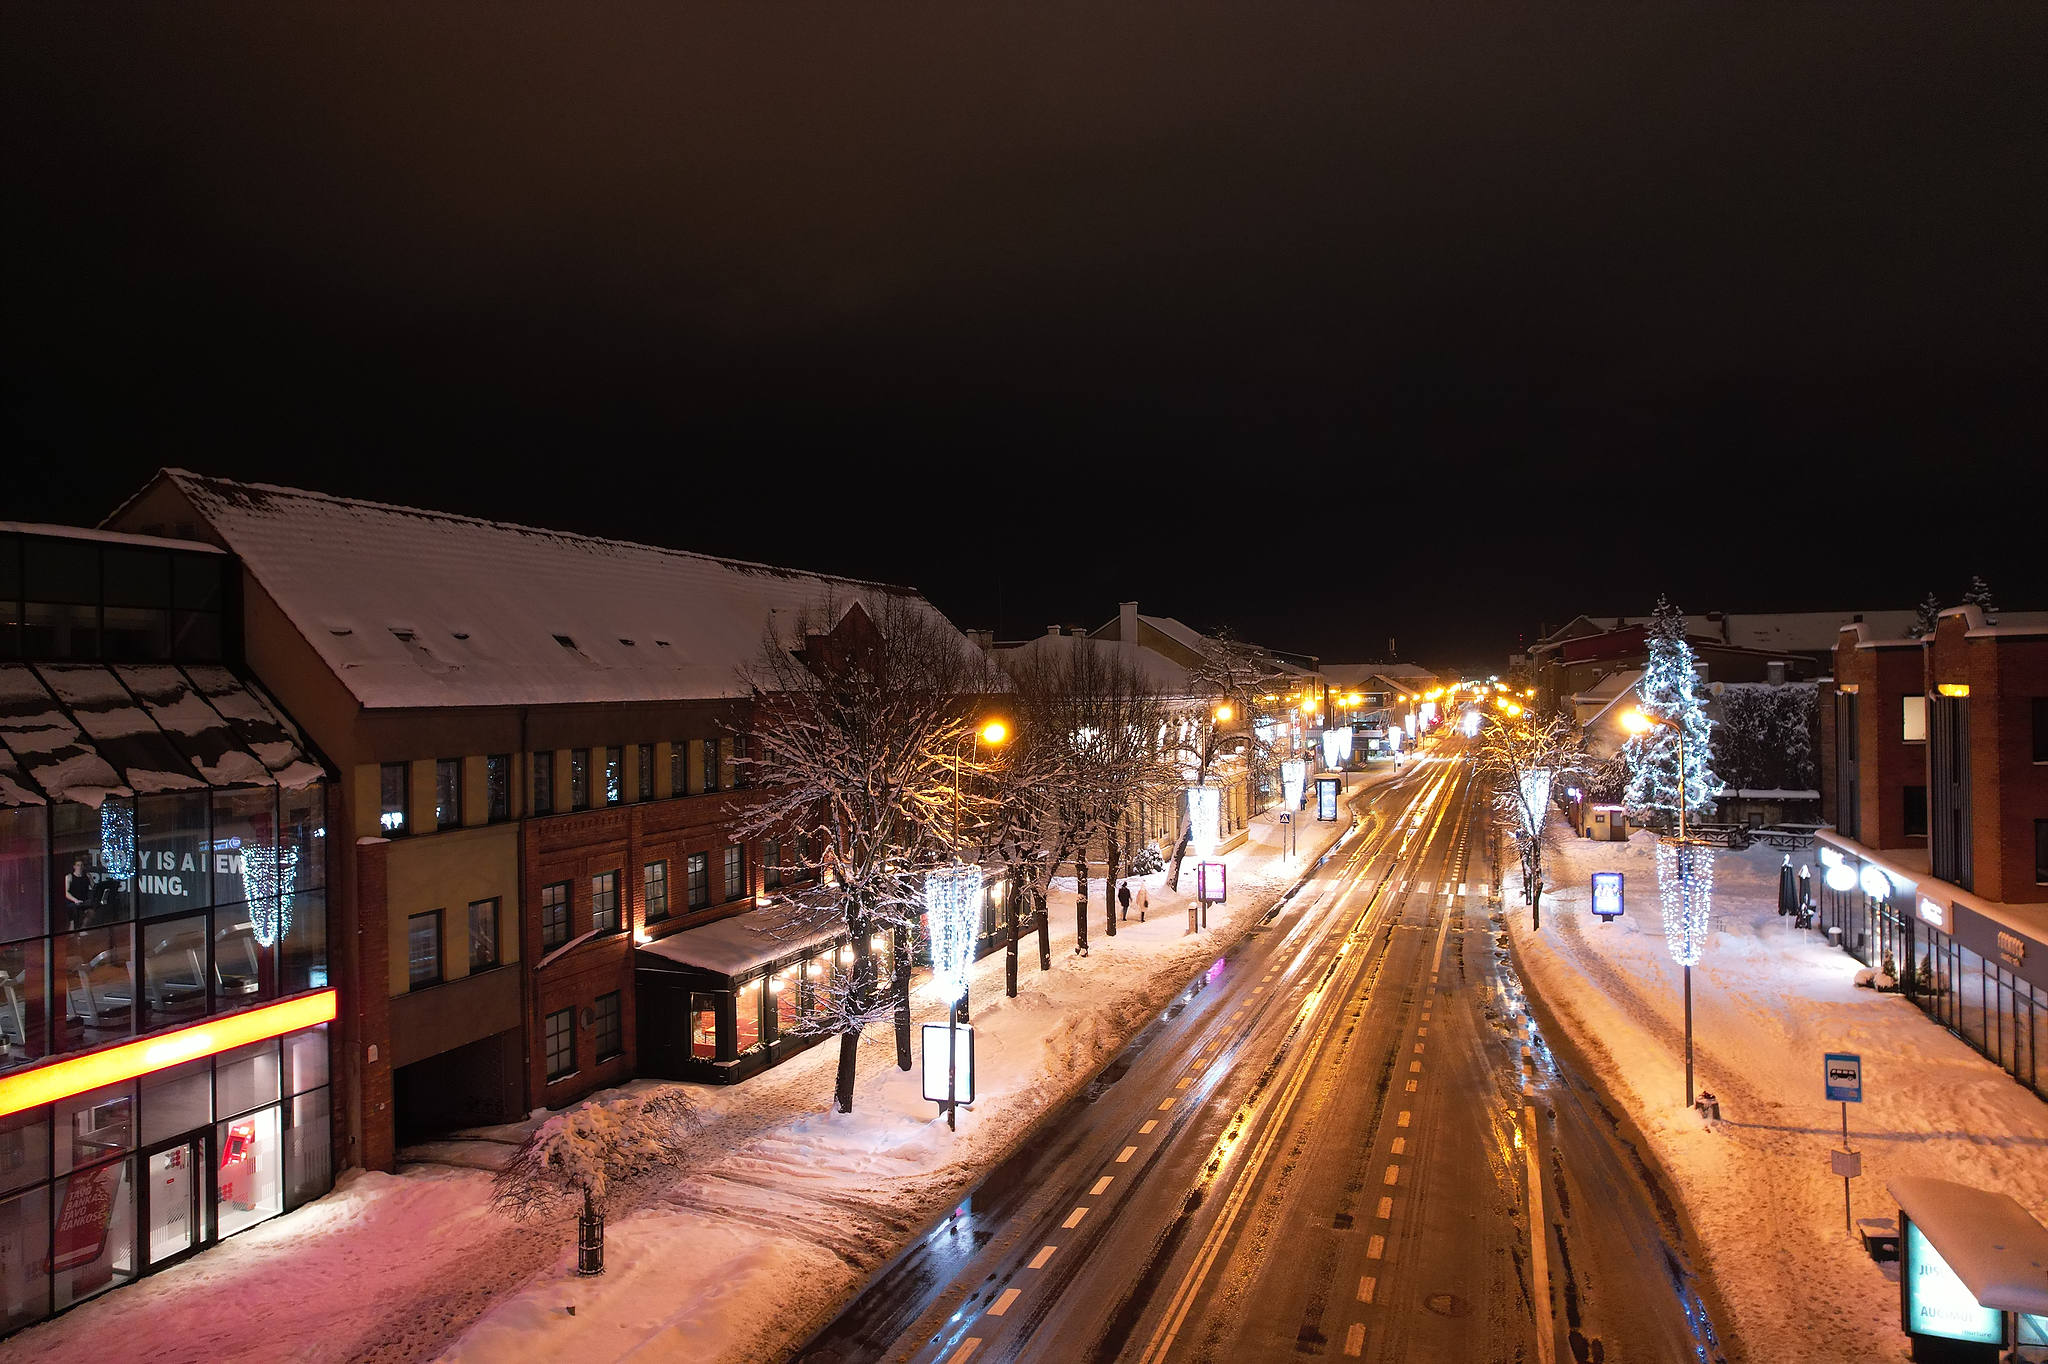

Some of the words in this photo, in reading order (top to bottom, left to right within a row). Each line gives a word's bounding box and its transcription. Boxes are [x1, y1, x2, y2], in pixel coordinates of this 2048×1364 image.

[88, 848, 151, 870] TODY
[157, 851, 175, 871] IS
[181, 852, 196, 872] A
